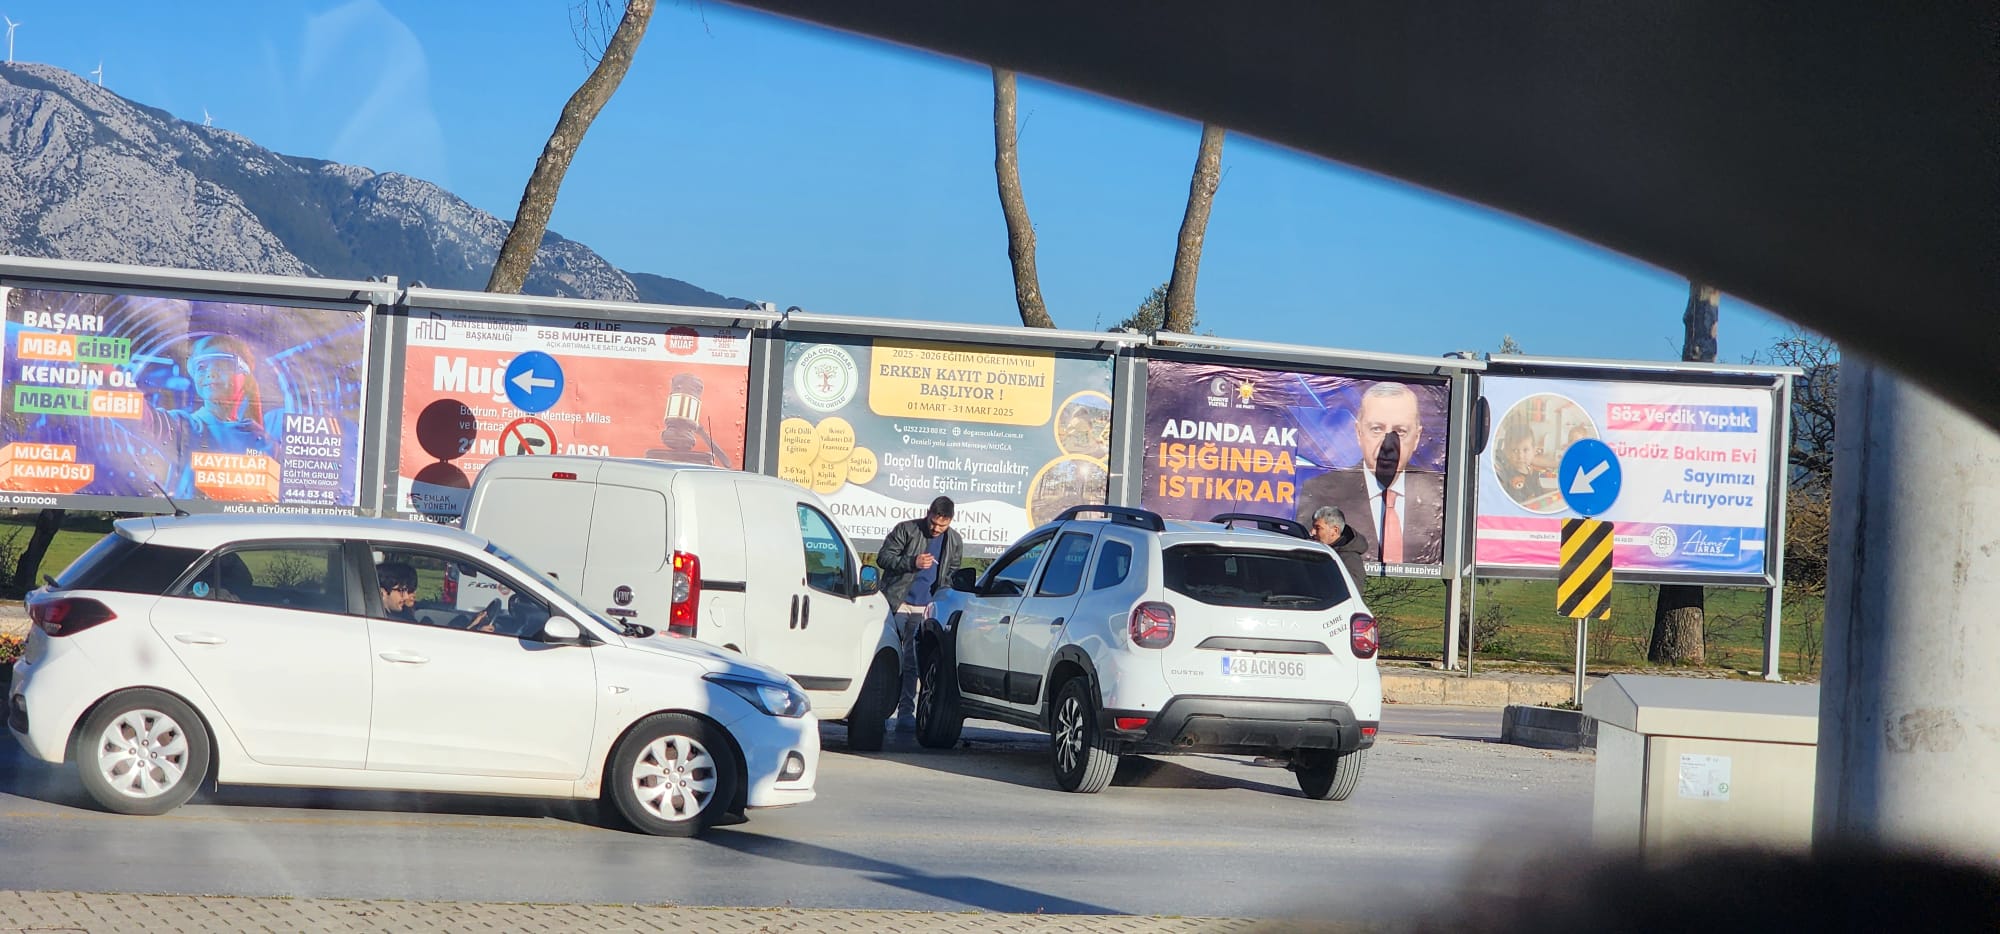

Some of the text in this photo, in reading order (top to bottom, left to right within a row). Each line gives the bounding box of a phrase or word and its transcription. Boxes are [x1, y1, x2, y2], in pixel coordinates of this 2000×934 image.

[23, 311, 104, 334] BAŞARI
[451, 320, 528, 332] KENTSEL DÖNÜŞÜM
[573, 321, 622, 332] 48 İLDE
[465, 331, 513, 342] BAŞKANLIĞI
[537, 330, 657, 346] 558 MUHTELİF ARSA
[670, 340, 694, 349] MUAF
[22, 338, 126, 359] MBA GİBİ!
[892, 349, 913, 359] 2025
[921, 351, 941, 361] 2026
[943, 352, 974, 363] EĞİTİM
[1020, 359, 1036, 368] YILI
[22, 365, 137, 388] KENDİN OL
[433, 355, 511, 403] Muğ
[880, 364, 1046, 388] ERKEN KAYIT DÖNEMİ
[920, 383, 994, 400] BAŞLIYOR
[20, 391, 140, 414] MBA'Lİ GİBİ!
[907, 401, 918, 411] 01
[919, 402, 946, 412] MART
[965, 406, 991, 415] MART
[993, 408, 1014, 417] 2025
[460, 405, 498, 418] Bodrum,
[541, 410, 584, 424] Menteşe,
[586, 412, 611, 424] Milas
[1611, 406, 1751, 430] Söz Verdik Yaptık
[286, 415, 329, 435] MBA
[459, 420, 507, 432] ve Ortaca'
[1161, 419, 1298, 447] ADINDA AK
[286, 435, 341, 447] OKULLARI
[458, 437, 476, 454] 21
[15, 444, 72, 461] MUĞLA
[285, 446, 341, 457] SCHOOLS
[1159, 441, 1295, 475] IŞIĞINDA
[1674, 446, 1726, 463] Bakım
[1732, 448, 1757, 464] Evi
[194, 455, 267, 470] KAYITLAR
[284, 459, 334, 470] MEDICANA
[884, 453, 1029, 477] Doço'lu Olmak Ayrıcalıktır;
[14, 464, 90, 480] KAMPÜSÜ
[197, 471, 266, 487] BAŞLADI!
[283, 470, 339, 480] EĞİTİM GRUBU
[1684, 468, 1755, 487] Sayımızı
[889, 473, 930, 491] Doğada
[932, 475, 968, 494] Eğitim
[970, 478, 1016, 494] Fırsattır
[1159, 475, 1294, 504] İSTİKRAR
[13, 496, 57, 505] OUTDOOR
[285, 489, 334, 499] 444 83 48
[424, 494, 450, 503] EMLAK
[1662, 489, 1754, 509] Artırıyoruz
[223, 504, 357, 518] MUĞLA BÜYÜKŞEHİR BELEDİYESİ
[423, 502, 457, 511] YÖNETİM
[830, 503, 887, 518] ORMAN
[409, 514, 461, 524] ERA OUTDOO
[959, 525, 1008, 542] SİLCİSİ!
[984, 545, 1005, 554] MUĞ
[1405, 565, 1441, 576] BELEDİYESİ
[1230, 658, 1247, 673] 48
[1251, 659, 1276, 675] ACM
[1279, 661, 1304, 676] 966
